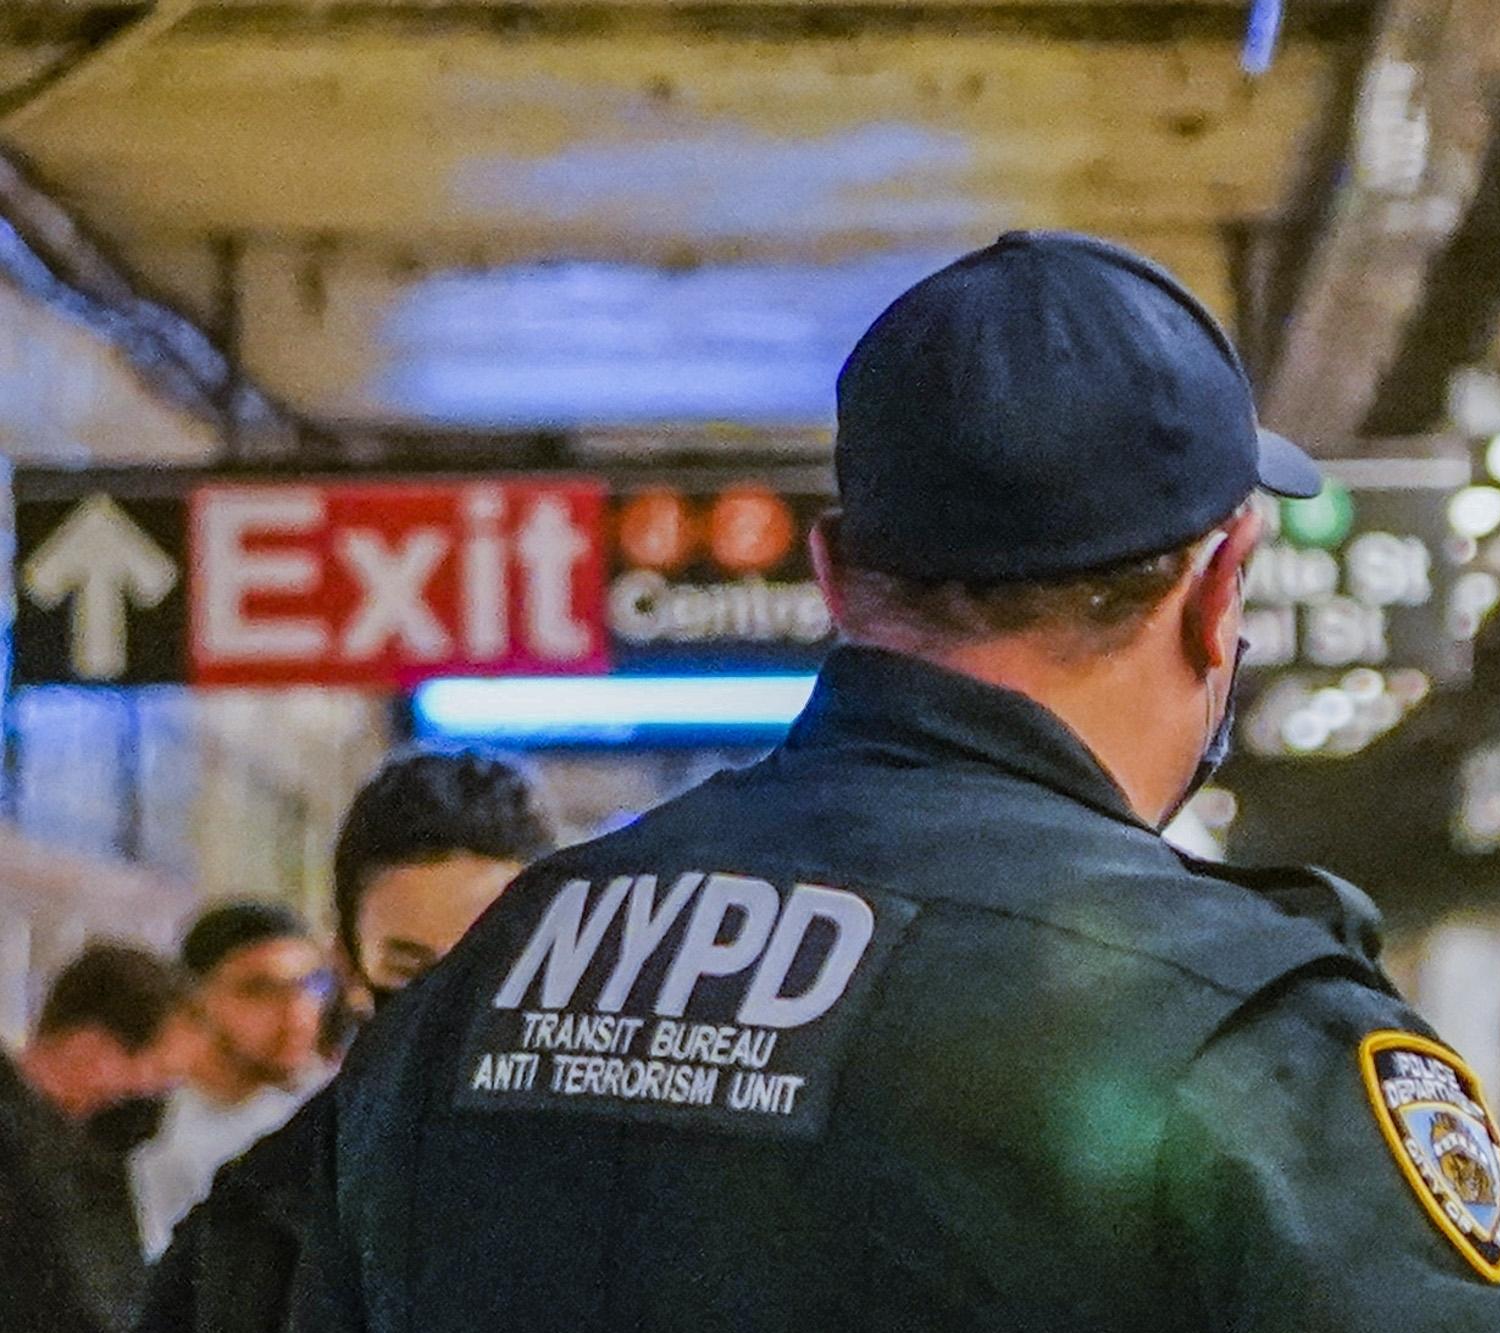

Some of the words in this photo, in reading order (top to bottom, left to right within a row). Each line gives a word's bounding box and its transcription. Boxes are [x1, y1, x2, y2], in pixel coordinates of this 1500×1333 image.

[196, 484, 592, 662] Exit
[495, 872, 874, 1029] NYPD
[523, 1013, 644, 1054] TRANSIT
[650, 1020, 777, 1069] BUREAU
[1394, 1051, 1461, 1091] POLICE
[472, 1053, 539, 1092] ANTI
[551, 1056, 718, 1105] TERRORISM
[726, 1073, 804, 1115] UNIT
